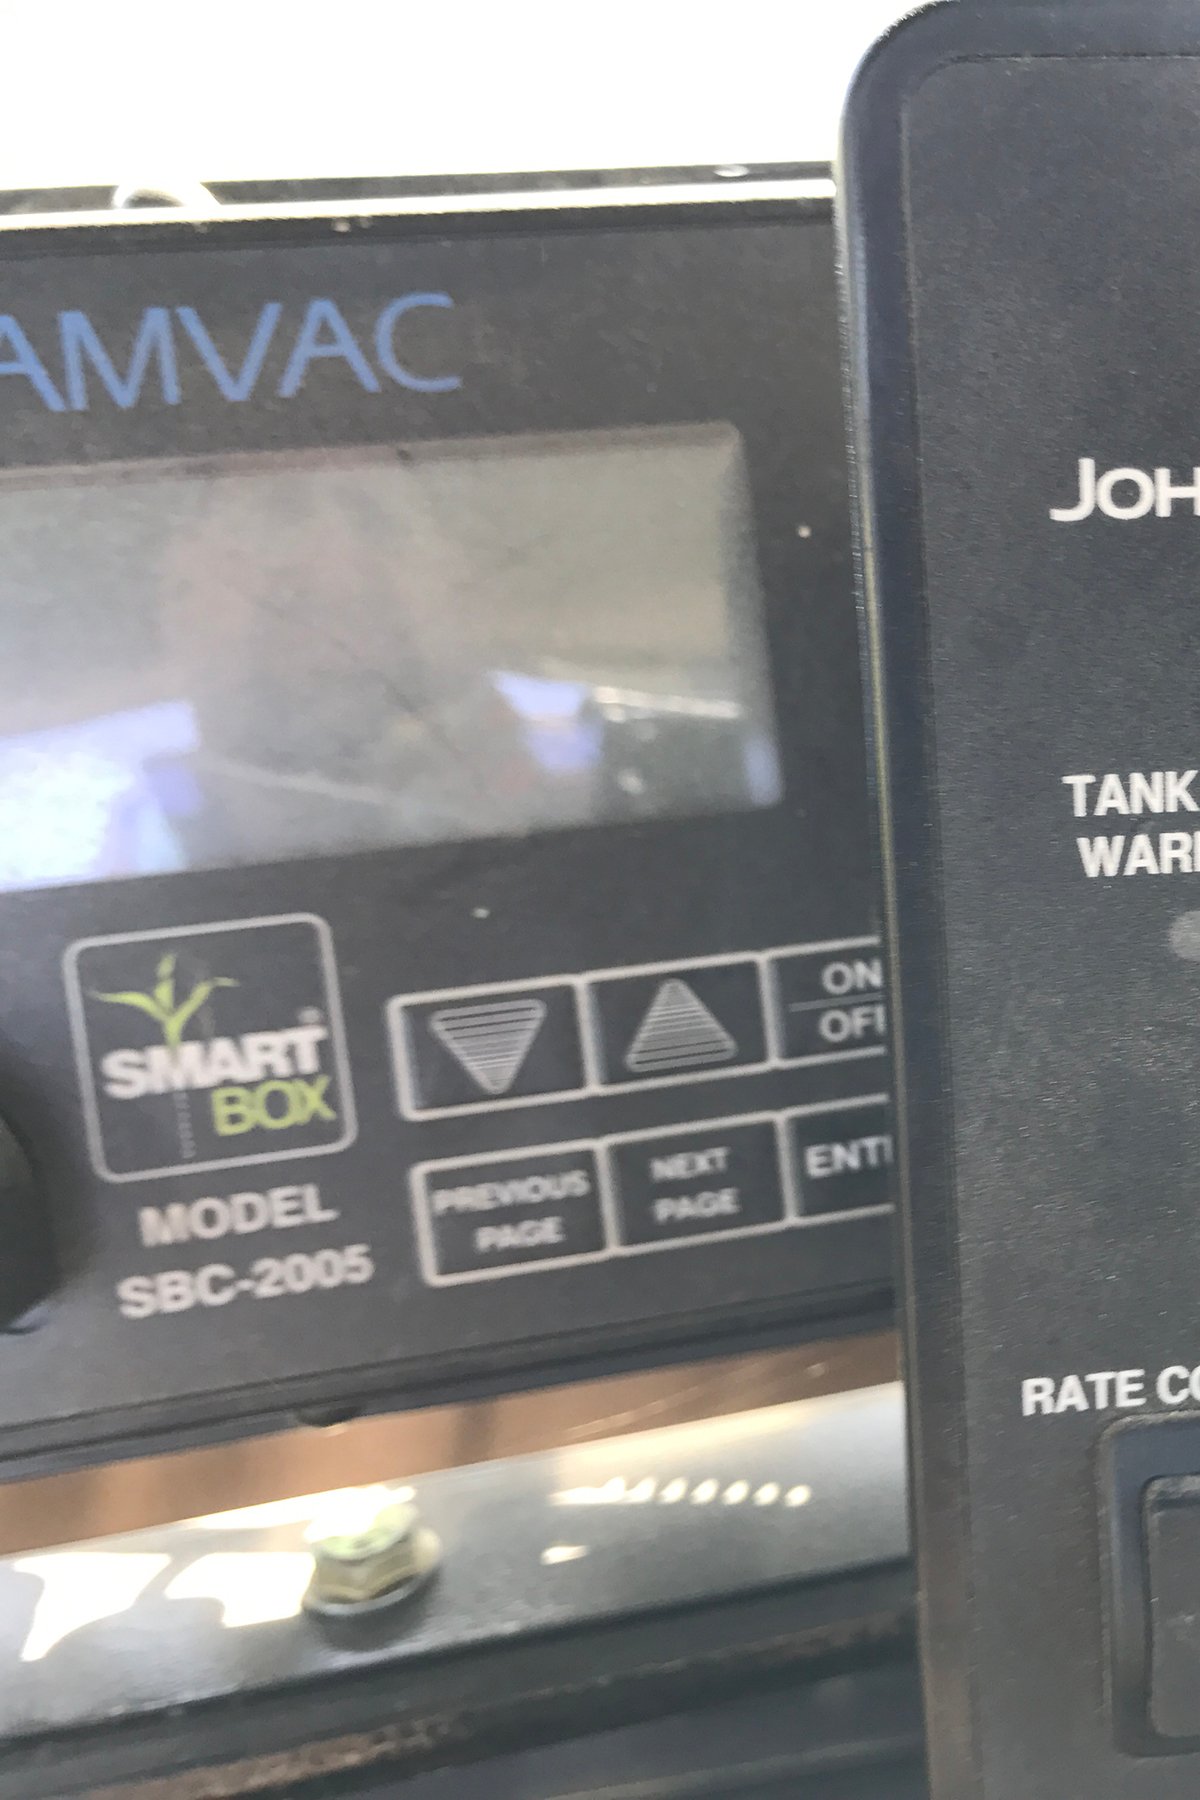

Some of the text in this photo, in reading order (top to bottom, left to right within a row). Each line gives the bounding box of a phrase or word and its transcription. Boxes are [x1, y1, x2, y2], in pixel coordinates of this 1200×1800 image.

[0, 291, 462, 412] AMVAC
[1062, 769, 1200, 817] TANK
[822, 958, 883, 995] ON
[101, 1025, 328, 1100] SMART
[211, 1075, 337, 1136] BOX
[651, 1147, 730, 1181] NEXT
[138, 1183, 340, 1247] MODEL
[430, 1170, 591, 1216] PREVIOUS
[654, 1186, 741, 1224] PAGE
[475, 1216, 565, 1252] PAGE
[116, 1243, 375, 1319] SBC-2005
[1022, 1368, 1146, 1416] RATE
